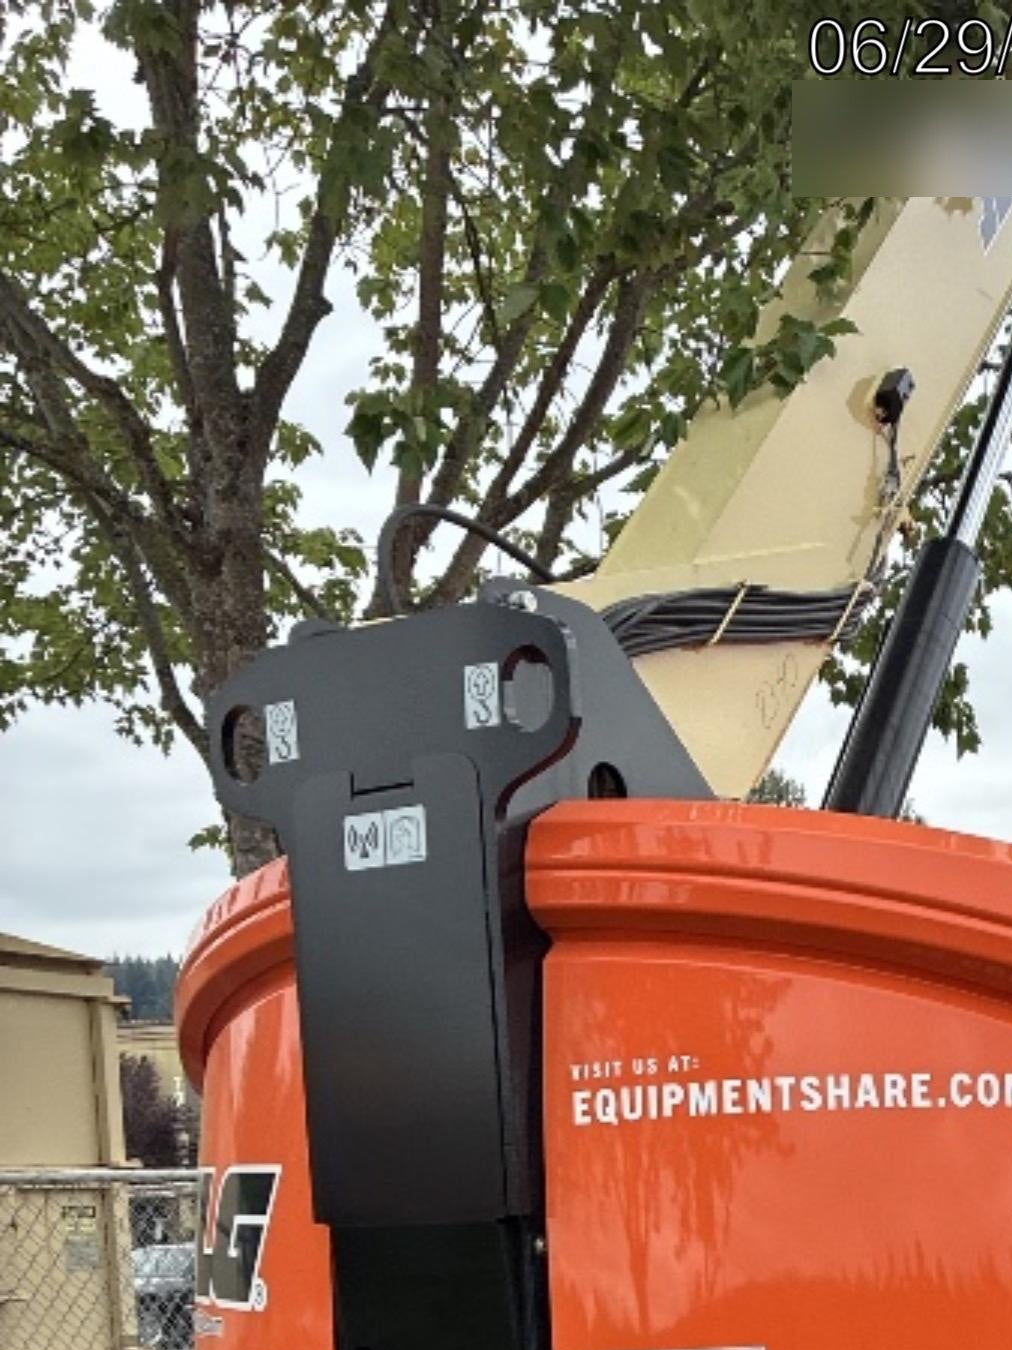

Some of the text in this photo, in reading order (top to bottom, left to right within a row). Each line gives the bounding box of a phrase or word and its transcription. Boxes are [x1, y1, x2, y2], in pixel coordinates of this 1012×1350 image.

[569, 1054, 701, 1081] VISIT US AT:
